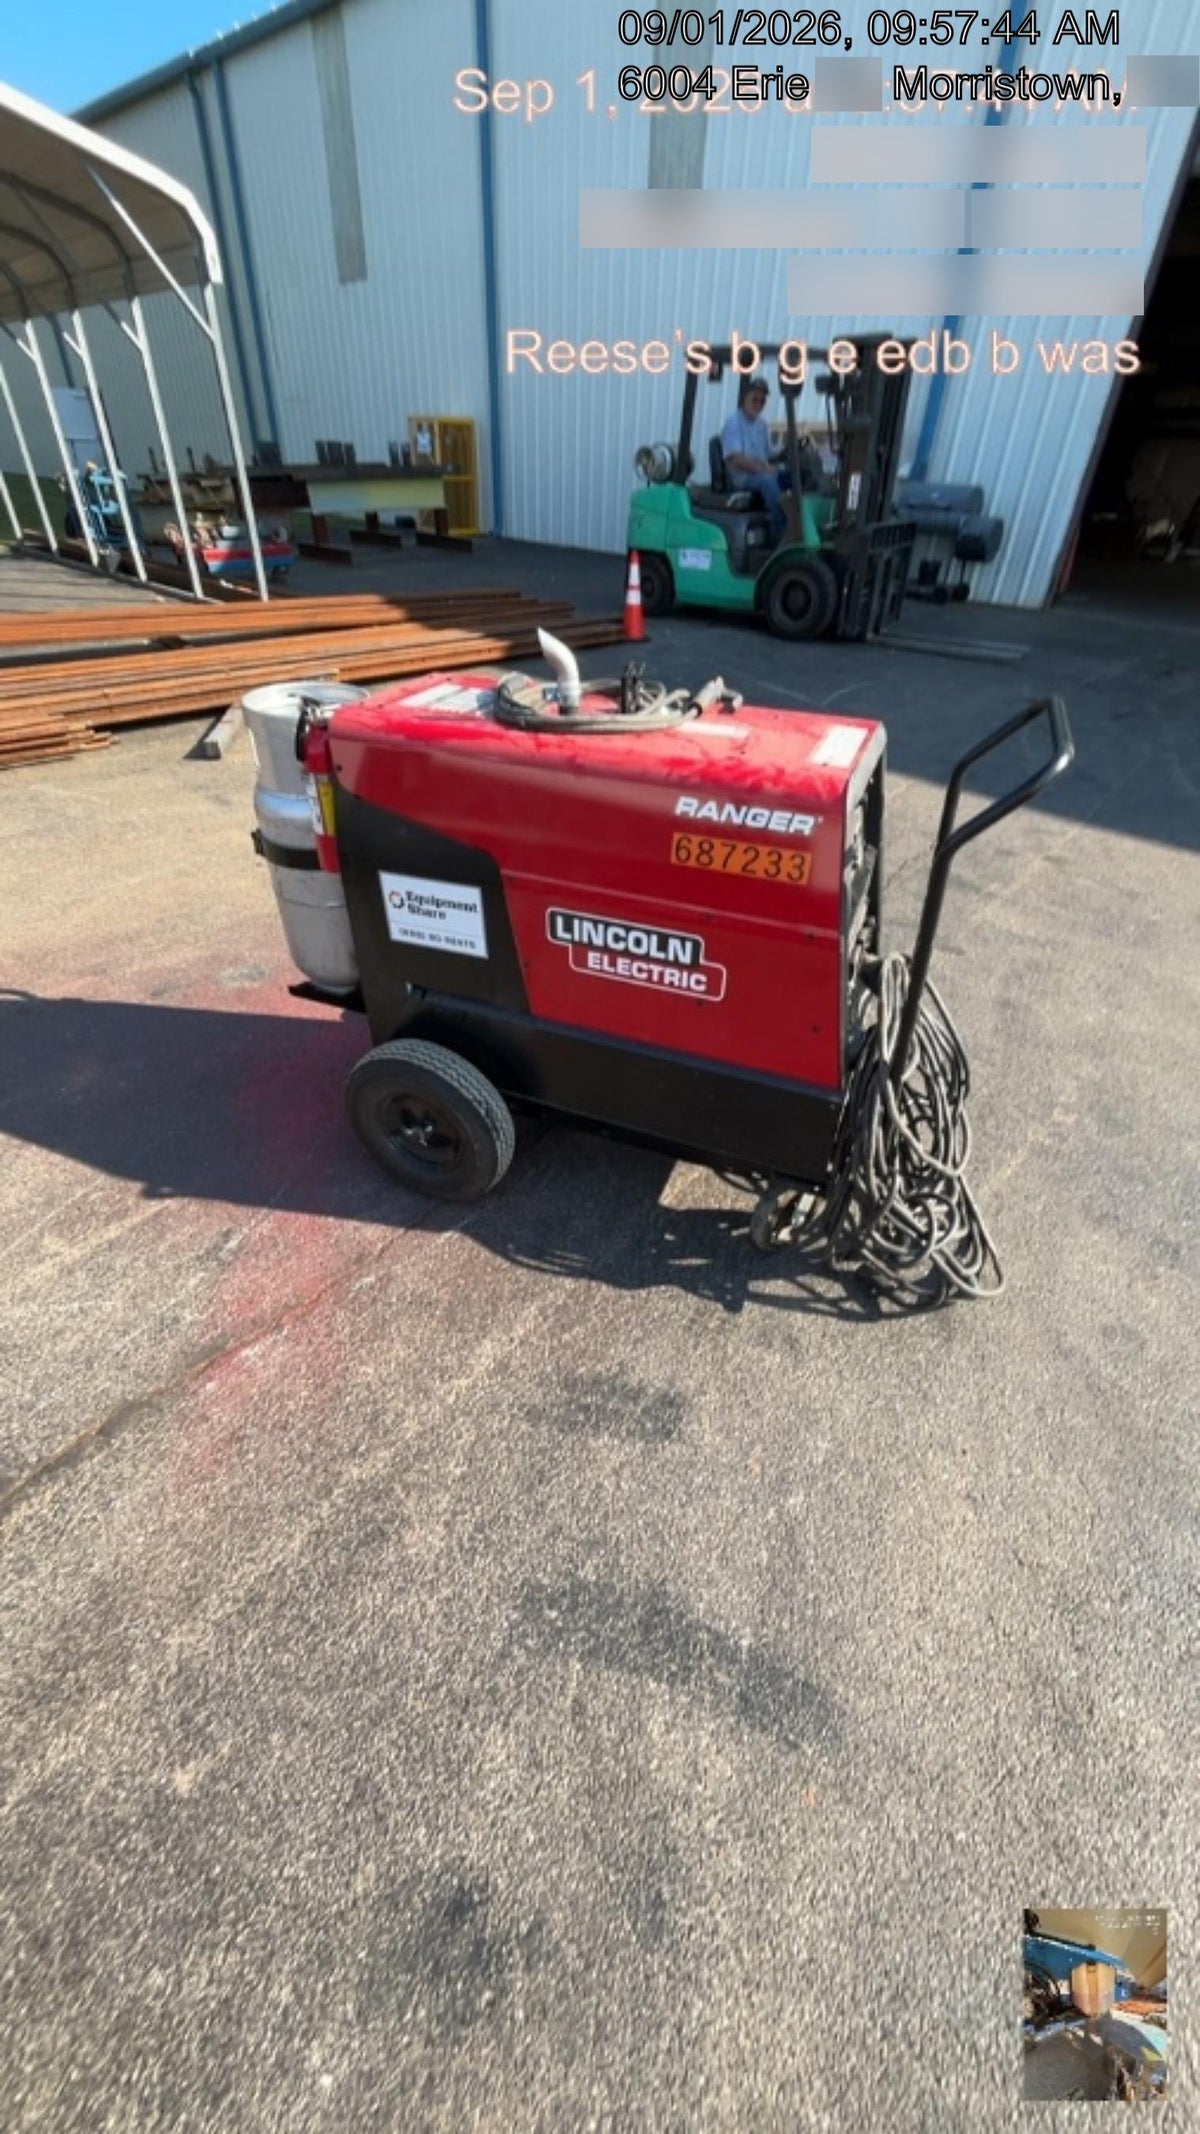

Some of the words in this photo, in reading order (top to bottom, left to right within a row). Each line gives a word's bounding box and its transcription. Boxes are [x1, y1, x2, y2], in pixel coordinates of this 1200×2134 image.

[674, 796, 815, 836] RANGER
[675, 835, 806, 882] 687233
[405, 890, 478, 913] Equipment
[406, 902, 447, 920] Share
[555, 914, 694, 965] LINCOLN
[587, 951, 708, 992] ELECTRIC
